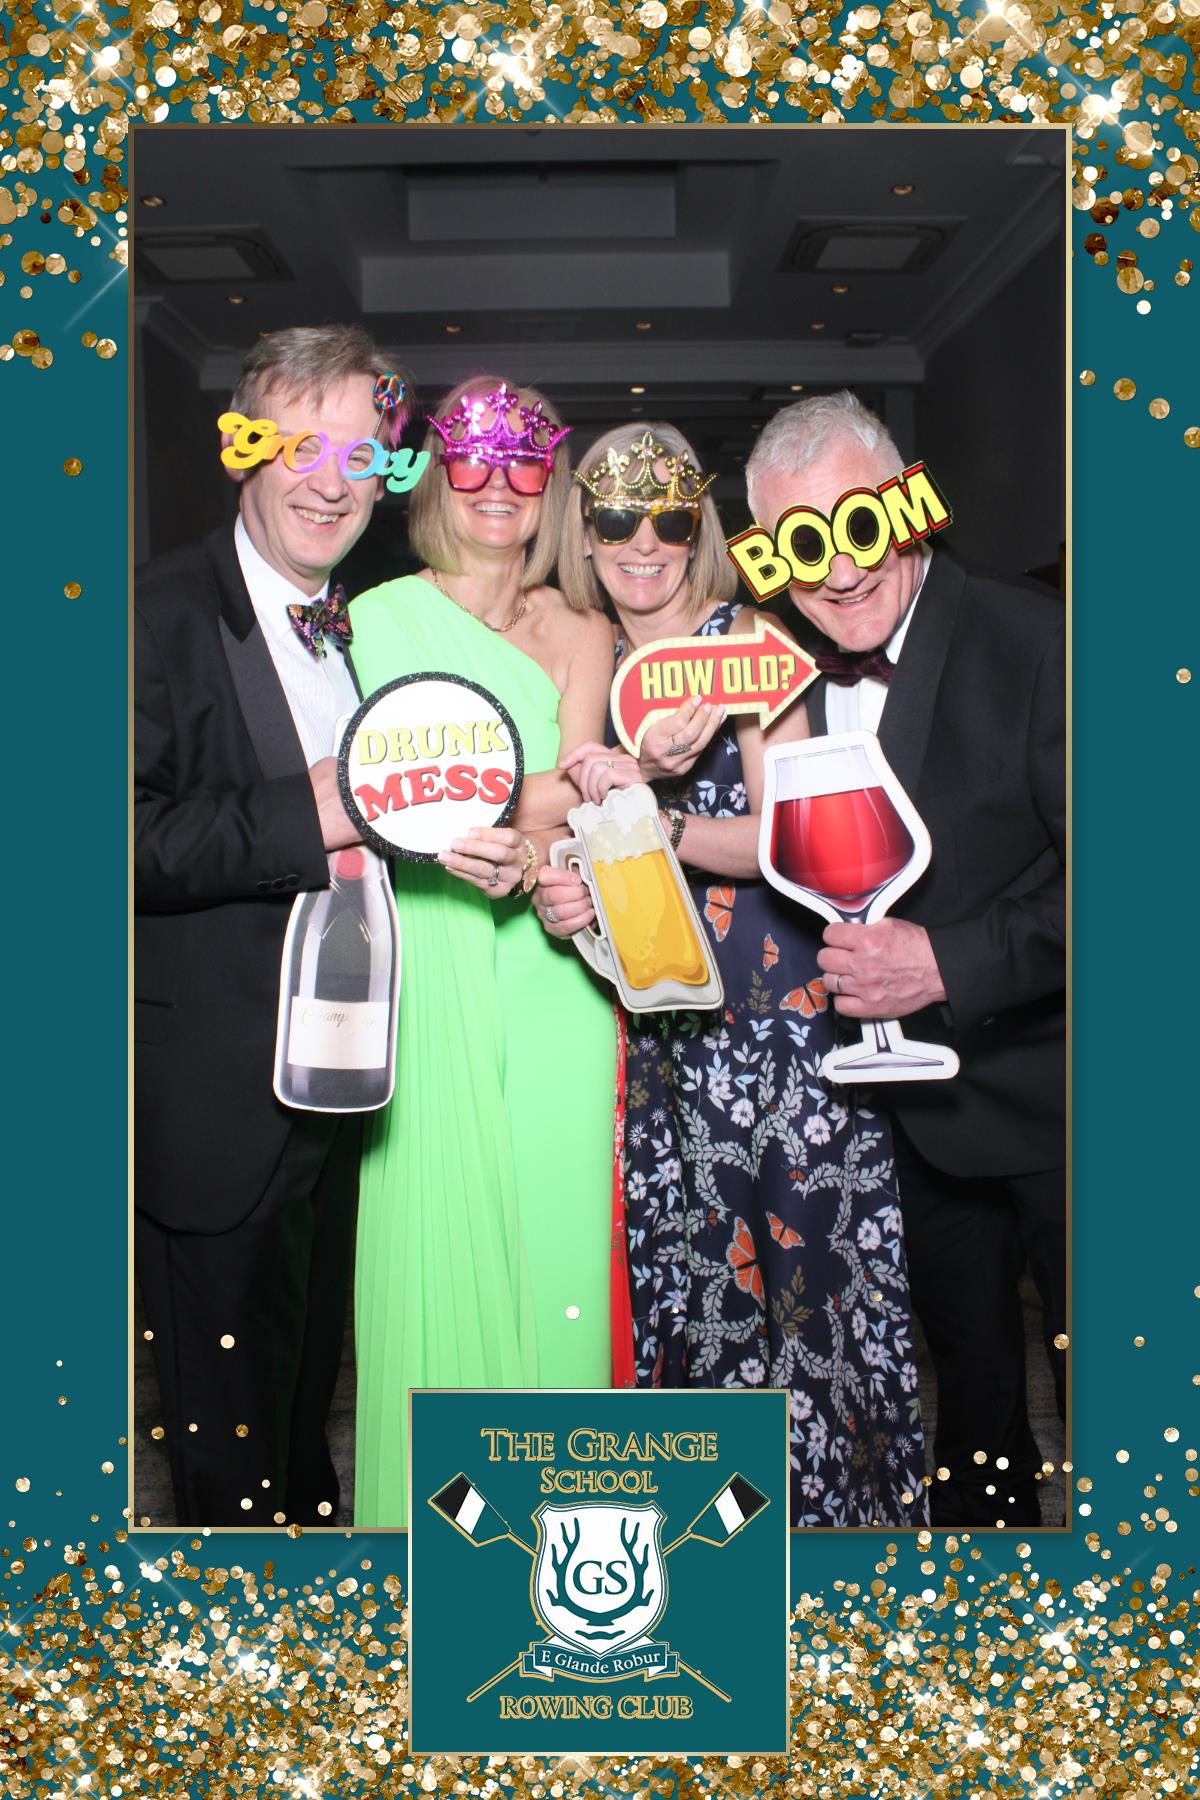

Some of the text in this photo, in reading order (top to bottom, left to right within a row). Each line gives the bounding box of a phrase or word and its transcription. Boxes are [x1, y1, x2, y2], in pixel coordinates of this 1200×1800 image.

[726, 461, 954, 603] BOOM
[640, 654, 797, 700] HOW OLD?
[356, 719, 509, 766] DRUNK
[353, 763, 514, 823] MESS
